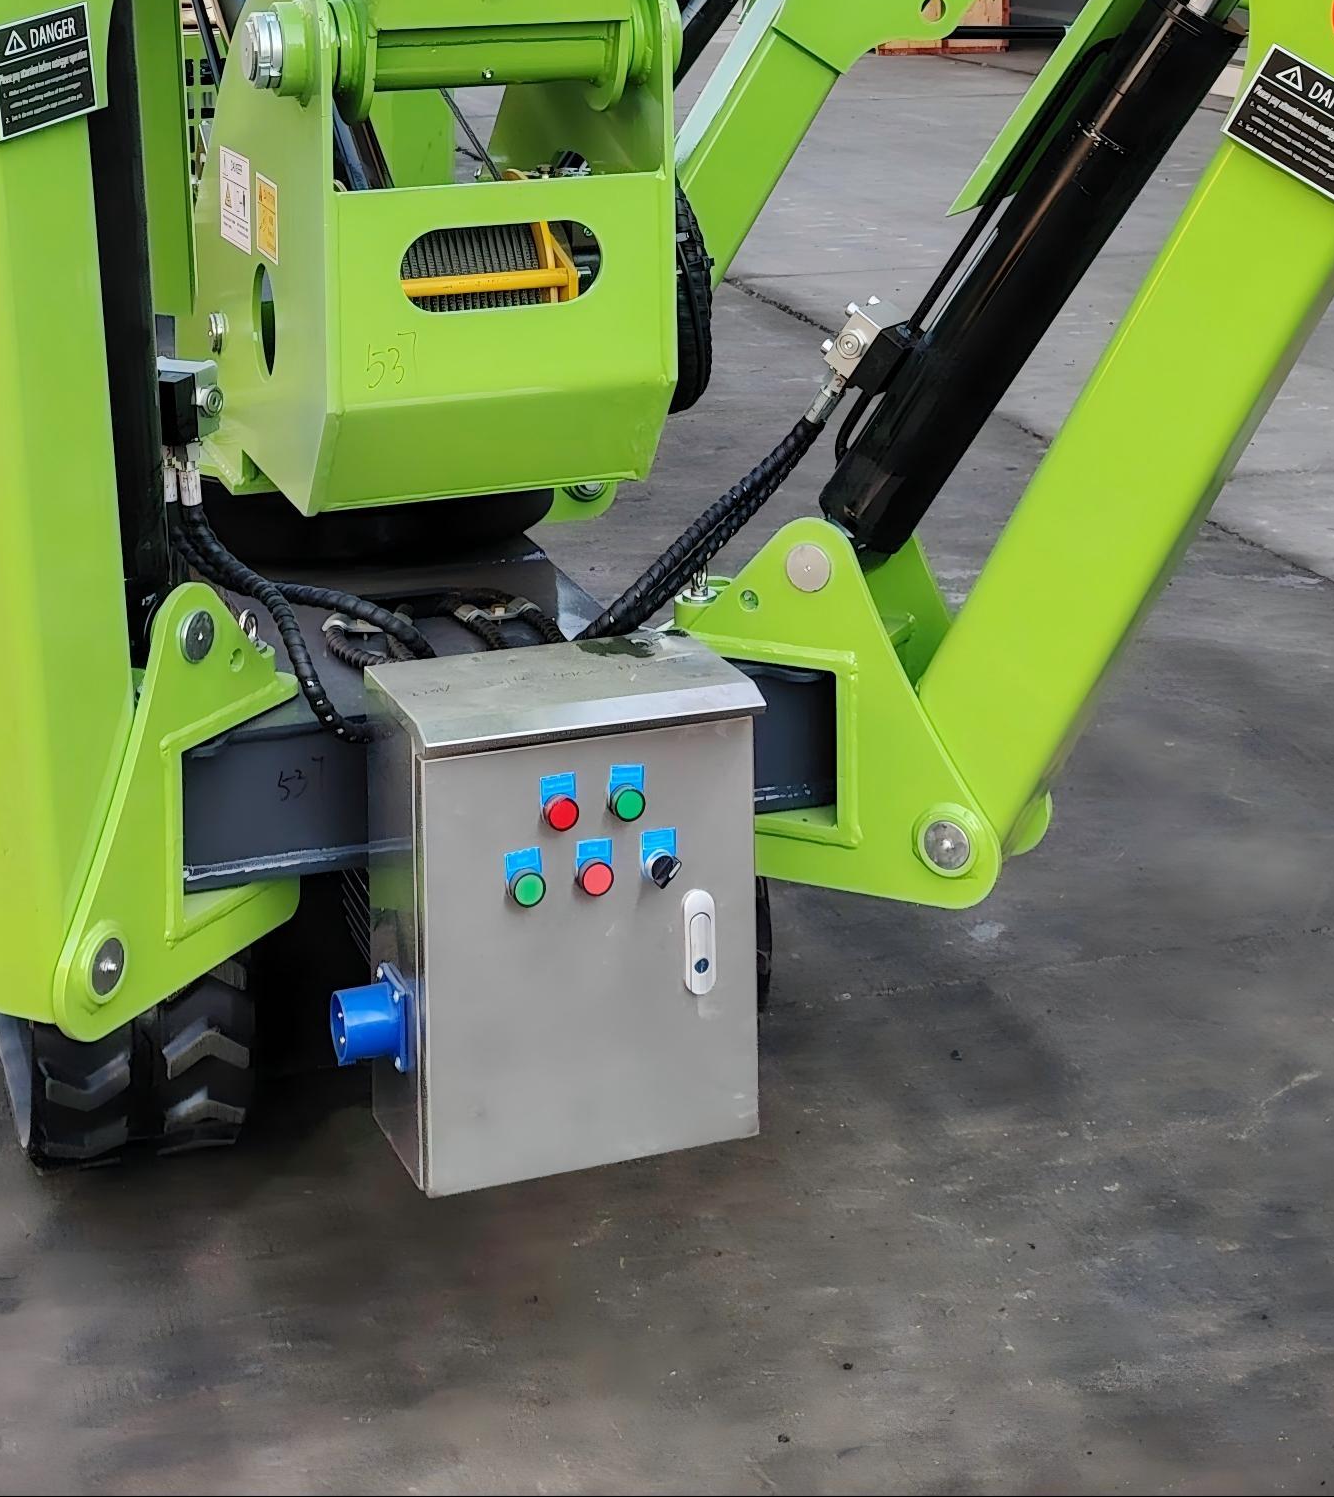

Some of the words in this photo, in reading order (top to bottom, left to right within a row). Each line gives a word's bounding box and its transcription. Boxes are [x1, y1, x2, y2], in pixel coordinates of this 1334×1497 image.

[29, 16, 76, 48] DANGER
[366, 331, 417, 389] 537
[277, 756, 324, 802] 537
